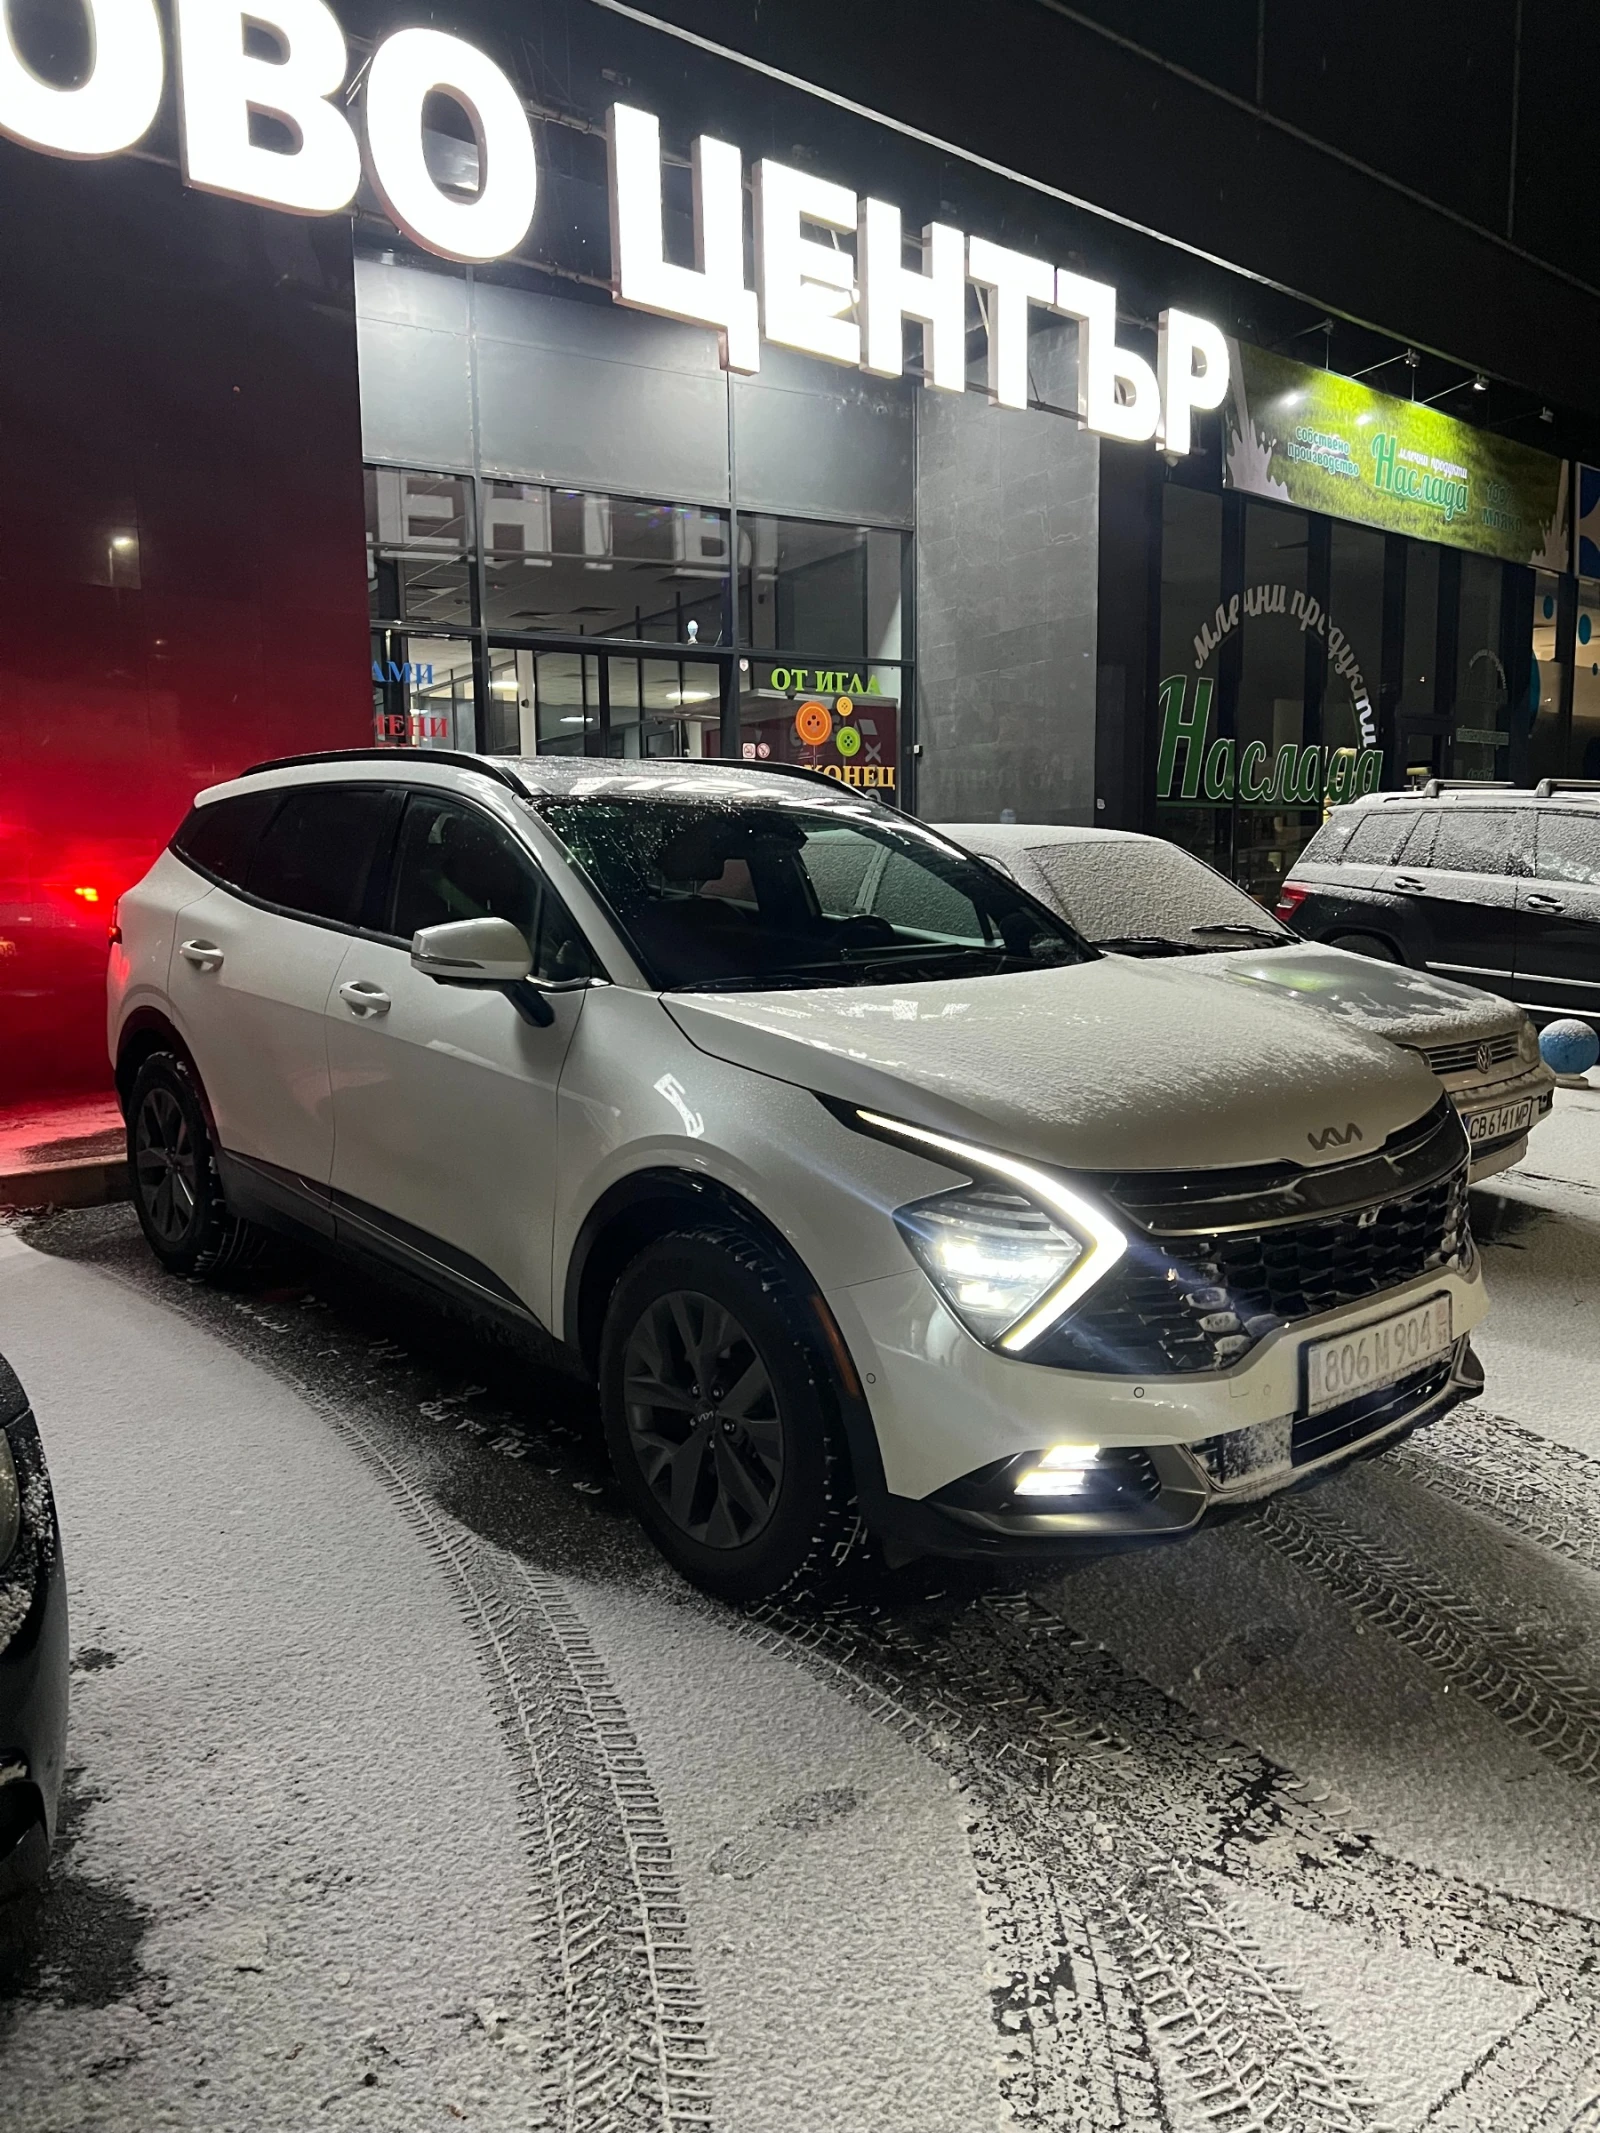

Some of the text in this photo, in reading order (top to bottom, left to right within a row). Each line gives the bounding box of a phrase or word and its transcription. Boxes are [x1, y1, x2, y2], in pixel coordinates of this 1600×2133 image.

[607, 103, 1229, 455] ЦЕНТЪР
[1287, 442, 1359, 477] производство
[1371, 432, 1469, 521] Наслада
[771, 668, 882, 695] ОТ ИГЛА
[1193, 584, 1377, 748] млечни продукти
[1157, 674, 1384, 804] Наслада
[1470, 1115, 1487, 1140] CB
[1488, 1107, 1514, 1136] 6141
[1325, 1337, 1369, 1392] 806
[1375, 1329, 1390, 1373] M
[1394, 1310, 1432, 1364] 904
